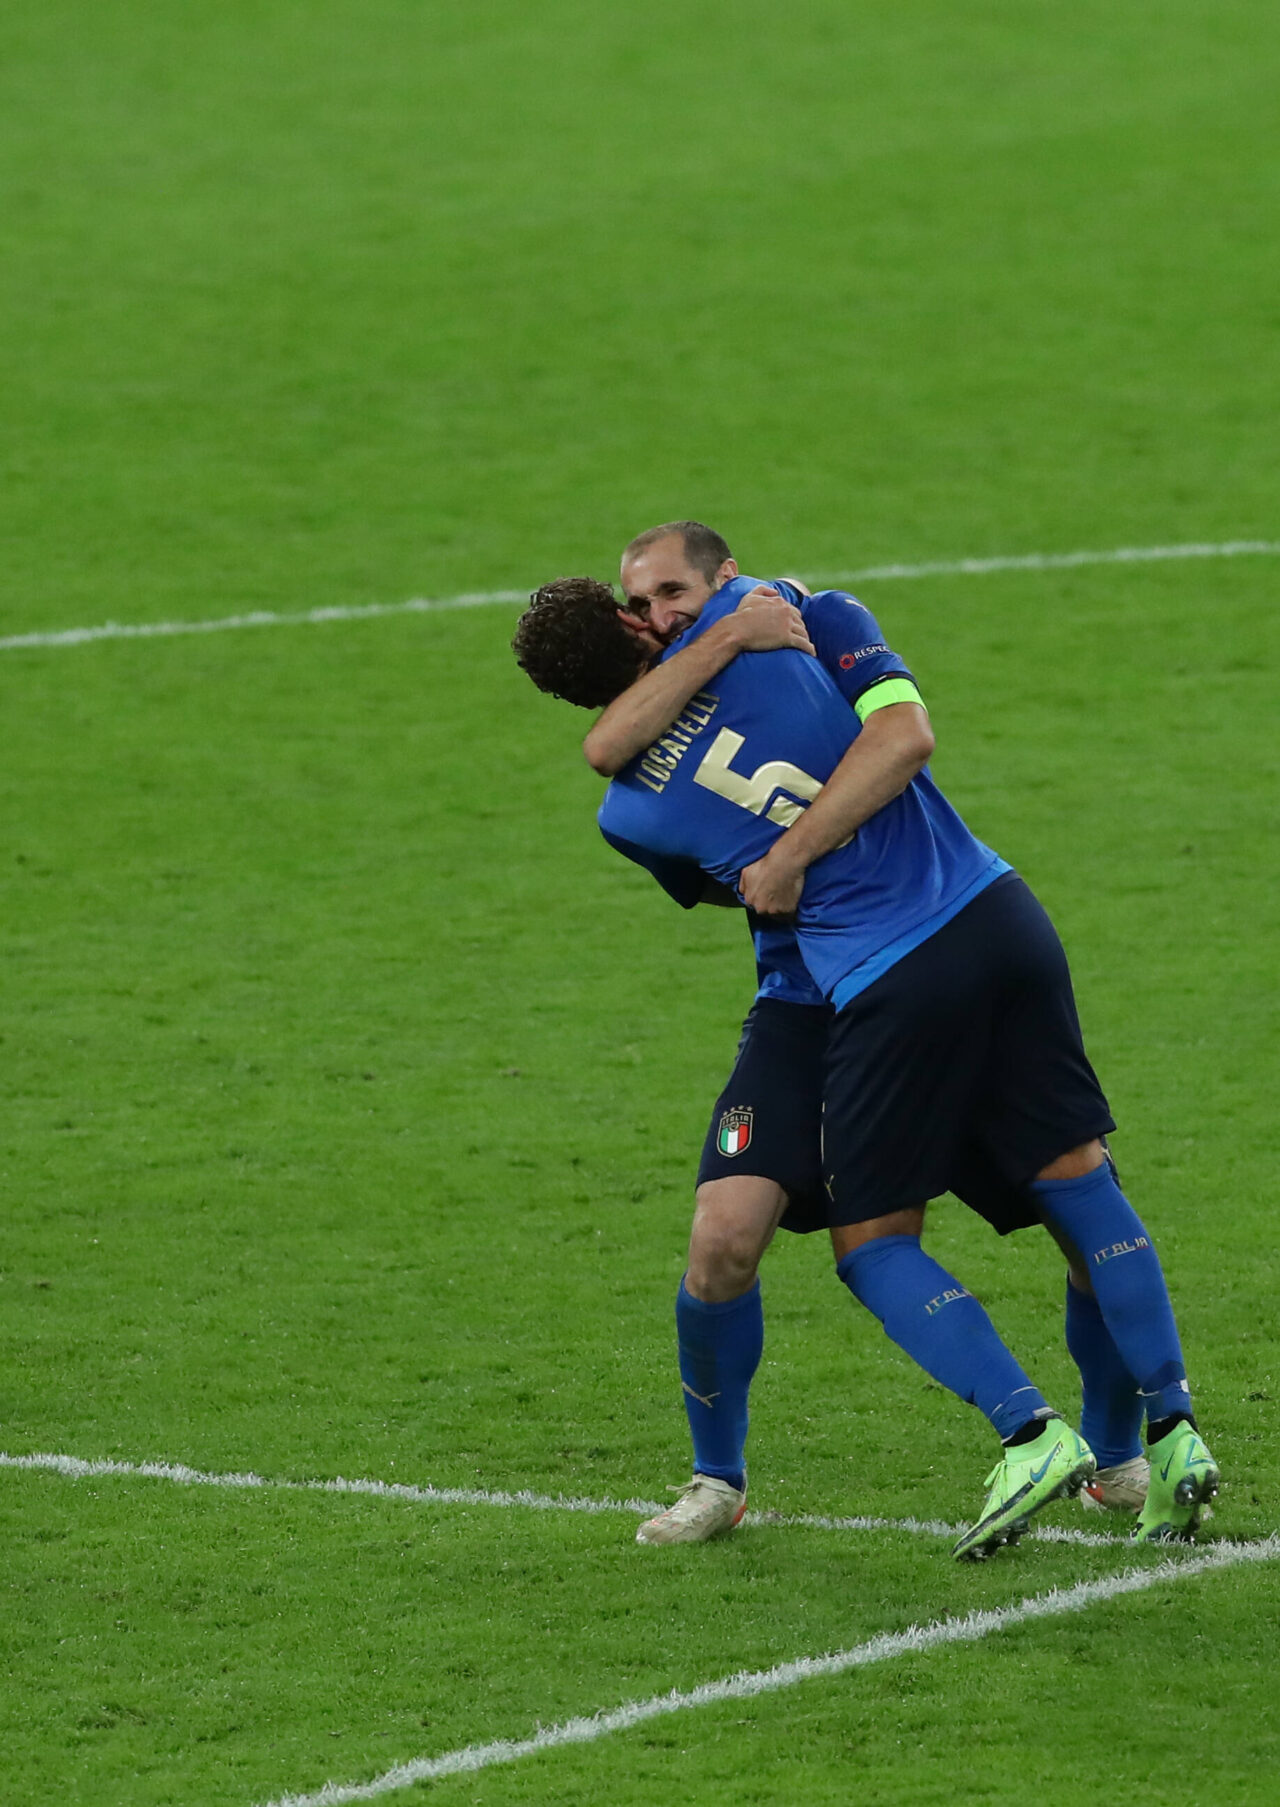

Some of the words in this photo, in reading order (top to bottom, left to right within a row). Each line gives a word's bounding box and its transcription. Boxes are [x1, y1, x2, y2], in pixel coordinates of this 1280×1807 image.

[854, 645, 890, 659] RESPEC
[635, 692, 720, 794] LOCATELLI
[693, 726, 855, 849] 5
[723, 1114, 749, 1126] ITALIA
[1094, 1237, 1148, 1264] ITALIA
